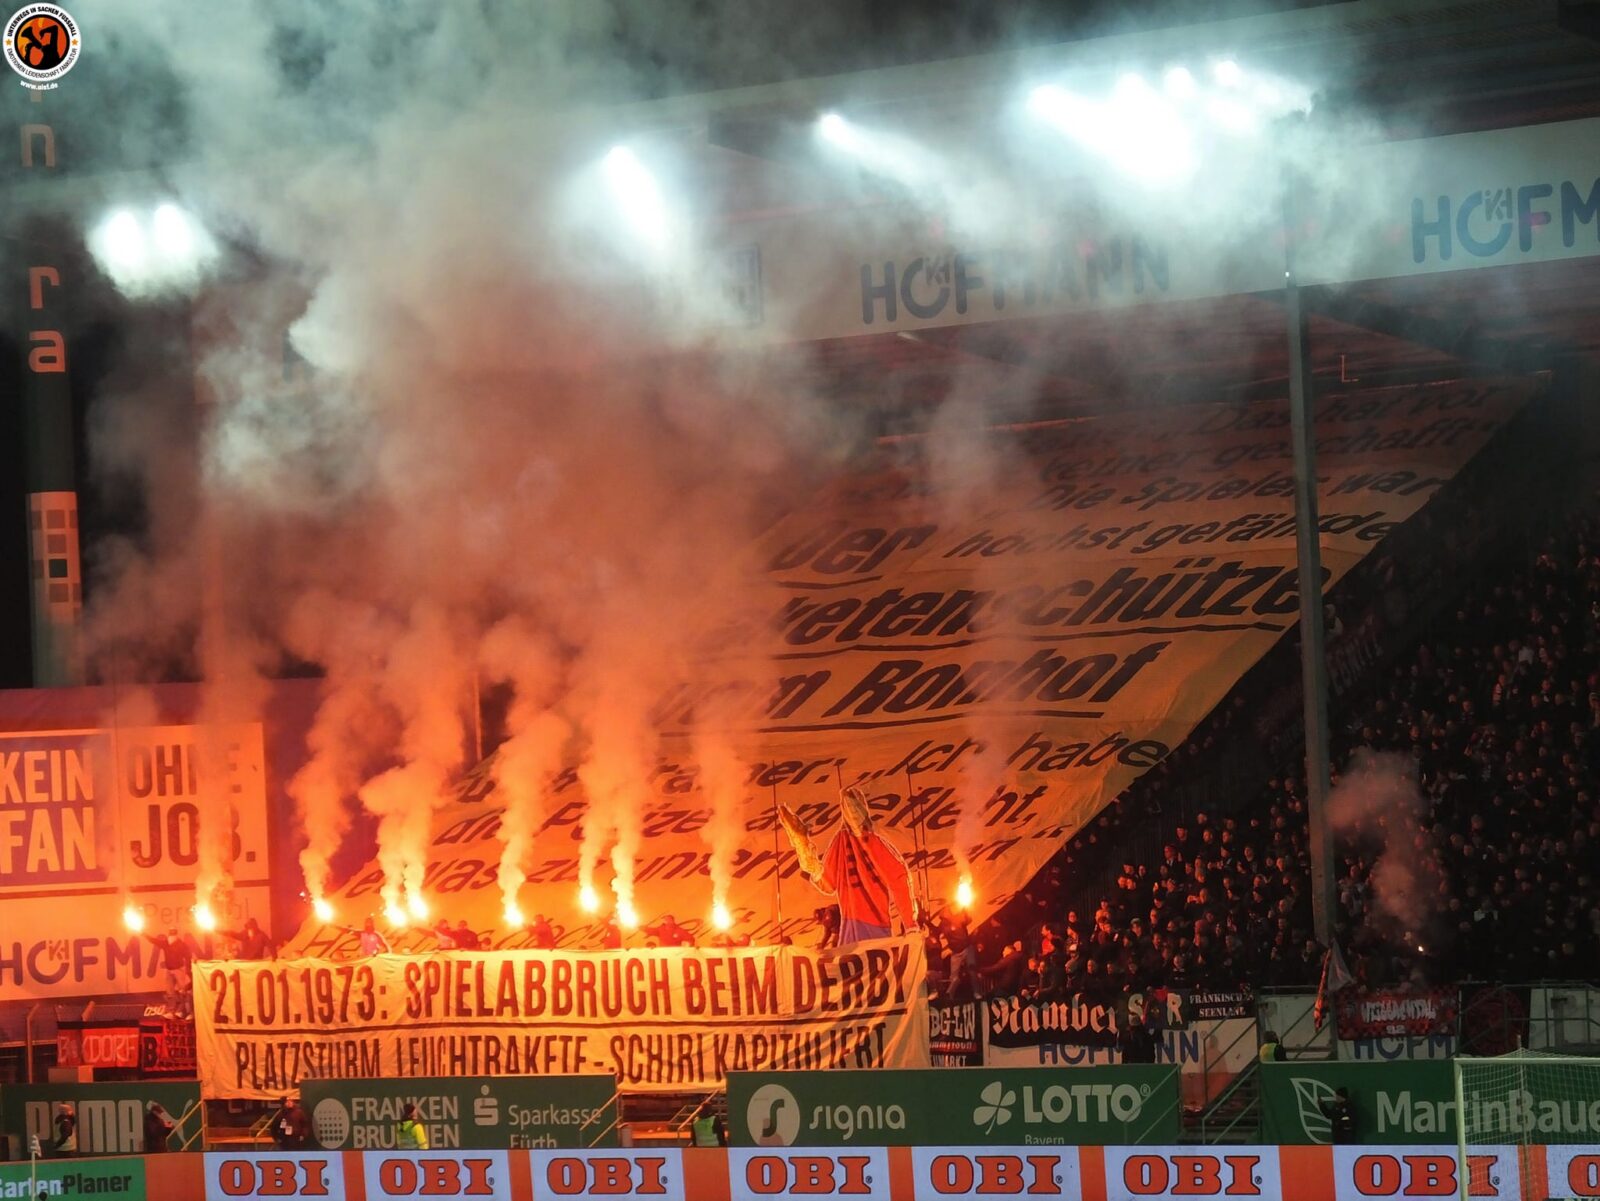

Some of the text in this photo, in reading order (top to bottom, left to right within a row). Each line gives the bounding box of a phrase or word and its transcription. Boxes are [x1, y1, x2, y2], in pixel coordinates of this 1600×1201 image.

[1004, 731, 1172, 772] habe
[0, 749, 94, 804] KEIN
[0, 807, 97, 874] FAN
[209, 943, 910, 1026] 21.01.1973: SPIELABBRUCH BEIM DERBY
[508, 1104, 602, 1127] Sparkasse
[808, 1100, 906, 1141] signia
[1023, 1083, 1142, 1124] LOTTO
[353, 1123, 460, 1149] BRUEN
[219, 1160, 328, 1196] OBI
[379, 1159, 493, 1195] OBI
[547, 1157, 667, 1195] OBI
[745, 1155, 872, 1195] OBI
[930, 1154, 1061, 1195] OBI
[1122, 1154, 1261, 1195] OBI
[1353, 1154, 1499, 1196] OBI
